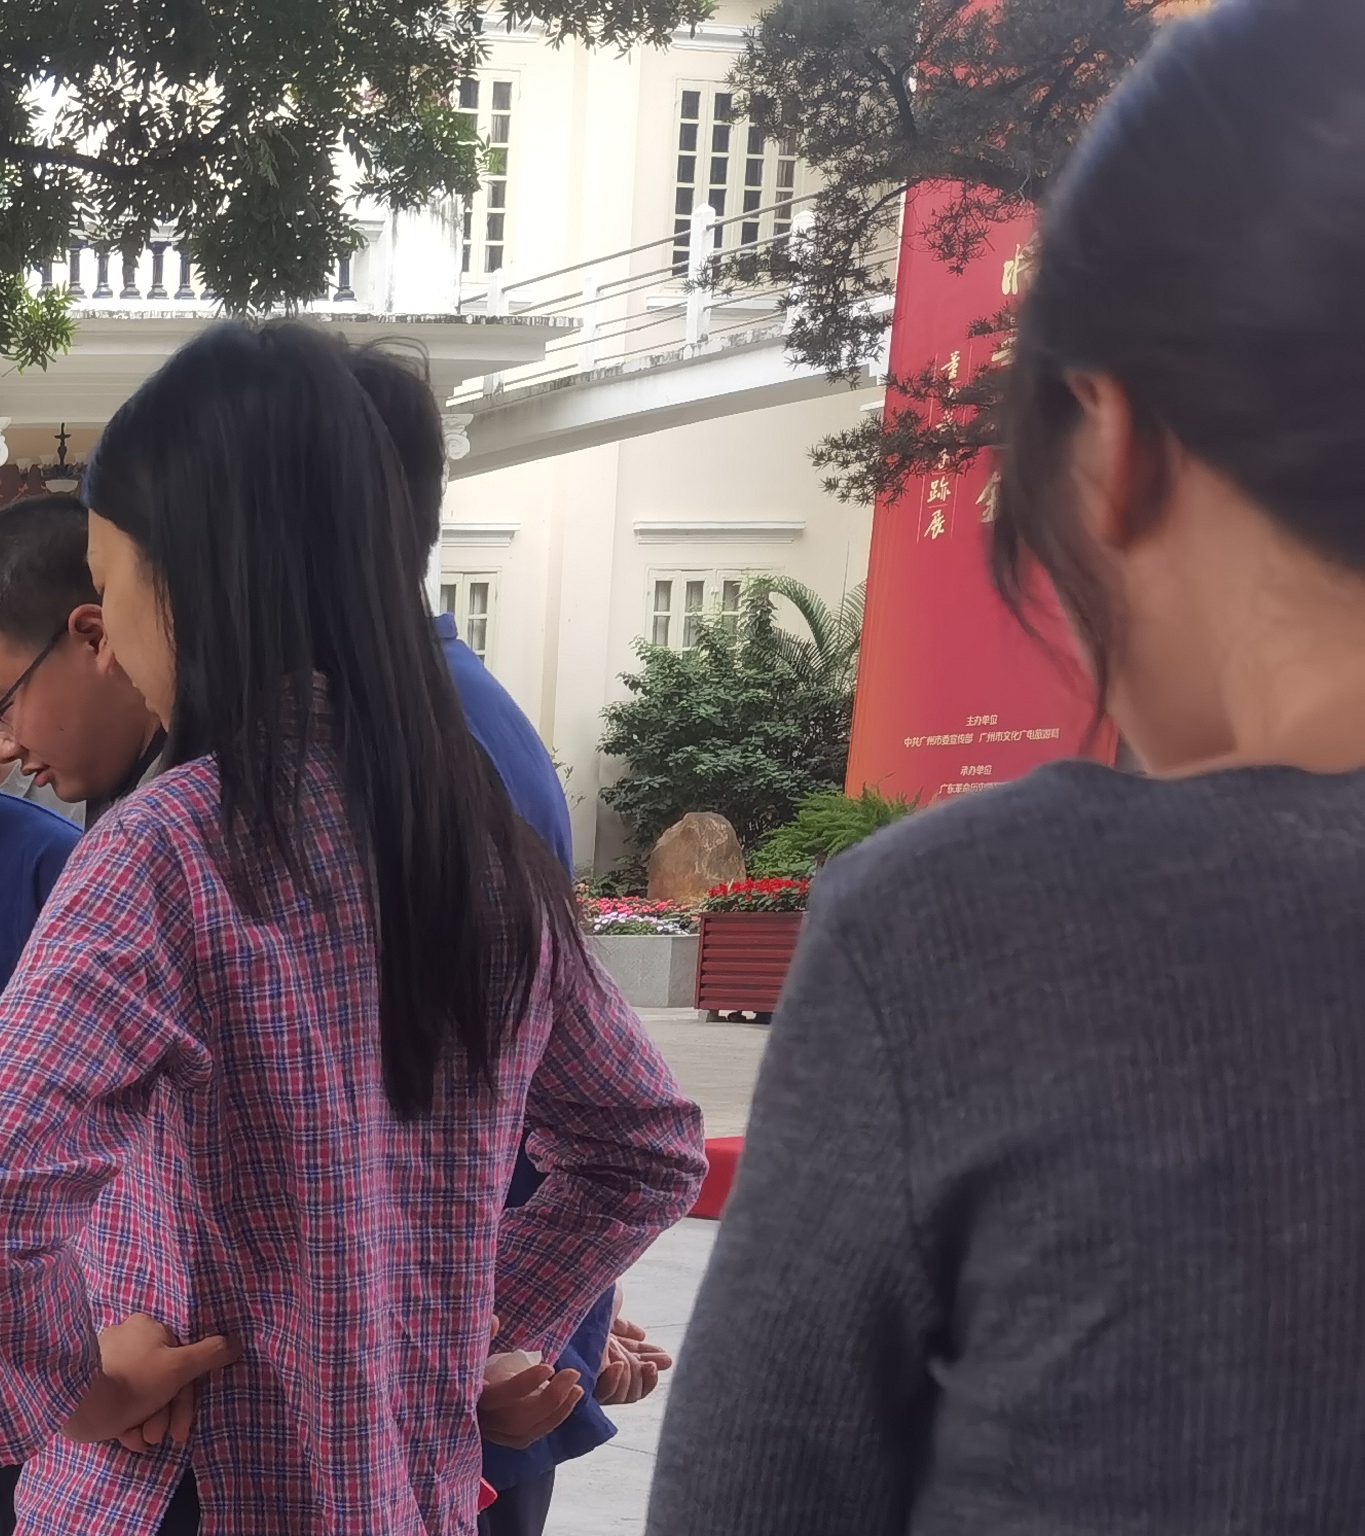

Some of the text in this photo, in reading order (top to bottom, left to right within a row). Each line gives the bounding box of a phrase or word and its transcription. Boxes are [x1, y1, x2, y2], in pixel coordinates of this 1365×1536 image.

[965, 714, 998, 726] 主办单位
[904, 728, 1060, 748] 中共广州市委宣传部 广州市文化广电旅游局
[960, 764, 992, 776] 承办单位
